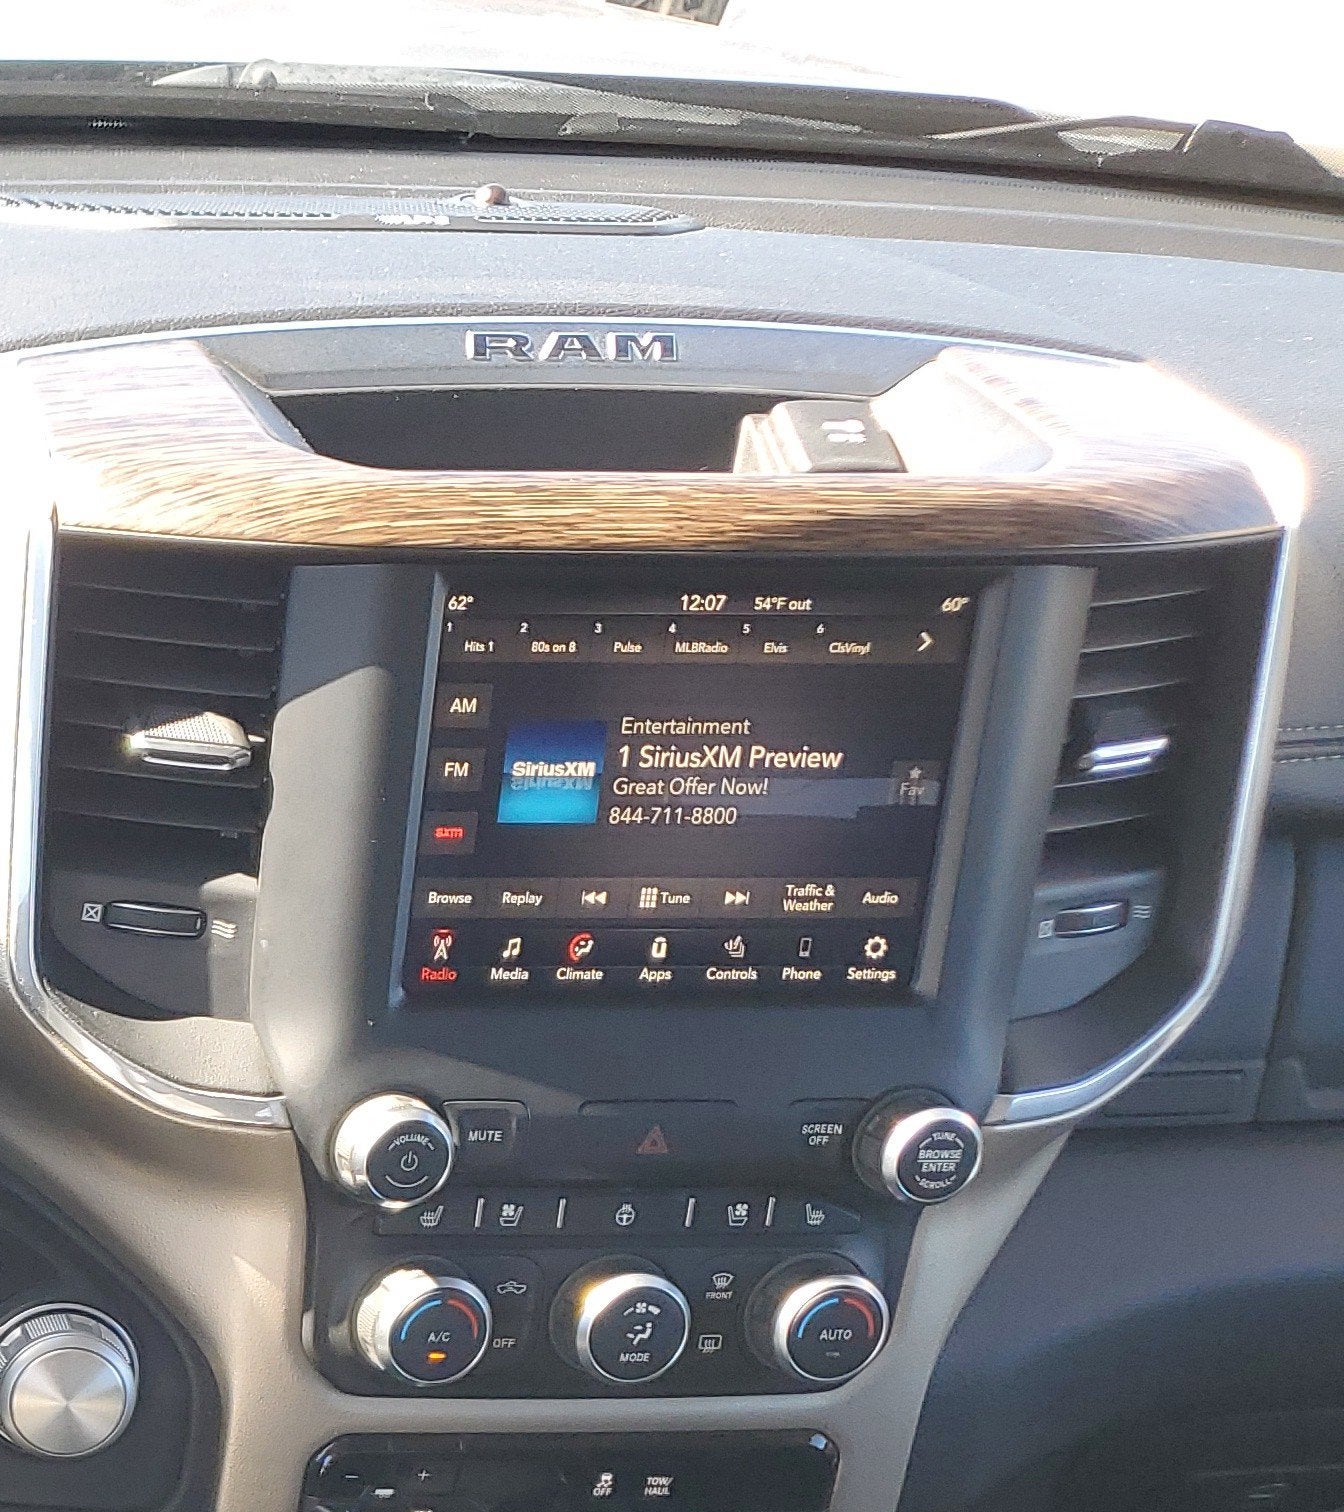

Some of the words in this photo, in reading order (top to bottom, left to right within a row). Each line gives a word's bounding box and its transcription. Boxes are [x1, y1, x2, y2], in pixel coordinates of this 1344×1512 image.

[465, 329, 678, 362] RAM
[448, 595, 475, 611] 62°
[680, 594, 727, 611] 12:07
[753, 597, 787, 611] 54°F
[788, 597, 812, 611] out
[446, 622, 453, 633] 1
[520, 622, 529, 633] 2
[594, 623, 602, 634] 3
[668, 622, 678, 634] 4
[742, 623, 751, 634] 5
[816, 624, 825, 634] 6
[464, 640, 485, 652] Hits
[488, 641, 495, 652] 1
[531, 641, 550, 653] 80s
[552, 643, 567, 652] on
[569, 641, 577, 652] 8
[614, 640, 643, 653] Pulse
[675, 641, 728, 653] MLBRadio
[763, 642, 788, 653] Elvis
[450, 697, 477, 713] AM
[620, 716, 752, 735] Entertainment
[619, 745, 631, 768] 1
[638, 744, 742, 768] SiriusXM
[748, 744, 843, 769] Preview
[444, 762, 470, 777] FM
[512, 761, 597, 777] SiriusXM
[613, 777, 665, 795] Great
[669, 776, 716, 795] Offer
[720, 777, 769, 795] Now!
[608, 806, 738, 825] 844-711-8800
[785, 884, 823, 897] Traffic
[824, 885, 836, 897] &
[428, 891, 473, 904] Browse
[502, 891, 543, 906] Replay
[660, 891, 691, 904] Tune
[862, 891, 899, 904] Audio
[783, 899, 834, 912] Weather
[421, 968, 457, 981] Radio
[490, 968, 529, 981] Media
[556, 967, 604, 981] Climate
[639, 968, 672, 984] Apps
[706, 966, 758, 981] Controls
[782, 967, 822, 981] Phone
[847, 967, 896, 982] Settings
[801, 1123, 843, 1135] SCREEN
[393, 1132, 430, 1147] VOLUME
[467, 1130, 503, 1142] MUTE
[808, 1135, 829, 1146] OFF
[918, 1149, 963, 1159] BROWSE
[920, 1162, 956, 1173] ENTER
[705, 1291, 733, 1300] FRONT
[427, 1331, 451, 1343] A/C
[819, 1329, 853, 1341] AUTO
[492, 1338, 516, 1348] OFF
[619, 1352, 650, 1363] MODE
[646, 1476, 674, 1486] TOW/
[593, 1486, 613, 1497] OFF
[644, 1486, 670, 1496] HAUL
